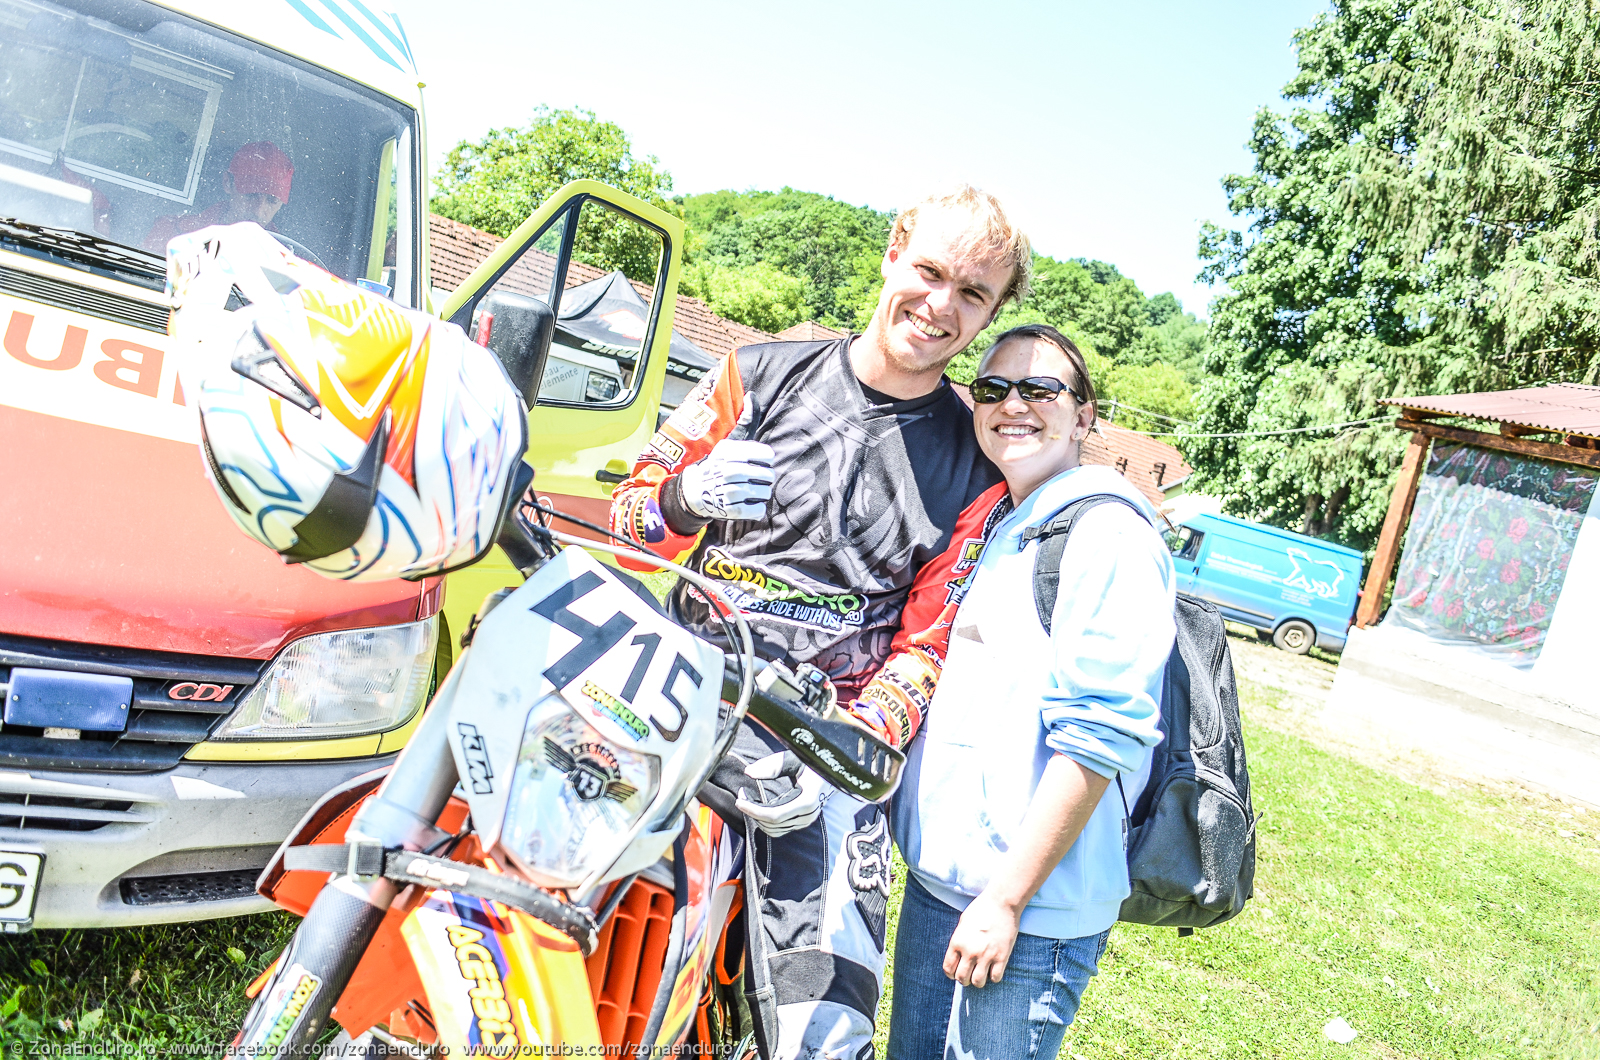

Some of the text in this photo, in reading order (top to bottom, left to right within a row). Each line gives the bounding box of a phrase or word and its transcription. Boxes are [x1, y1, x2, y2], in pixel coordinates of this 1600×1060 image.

[767, 600, 796, 617] RIDE
[793, 603, 823, 623] WITH
[822, 611, 842, 629] US!
[529, 570, 703, 742] 415
[168, 682, 234, 702] CDI
[581, 680, 650, 738] ZONAENDURO
[458, 722, 494, 795] KTM
